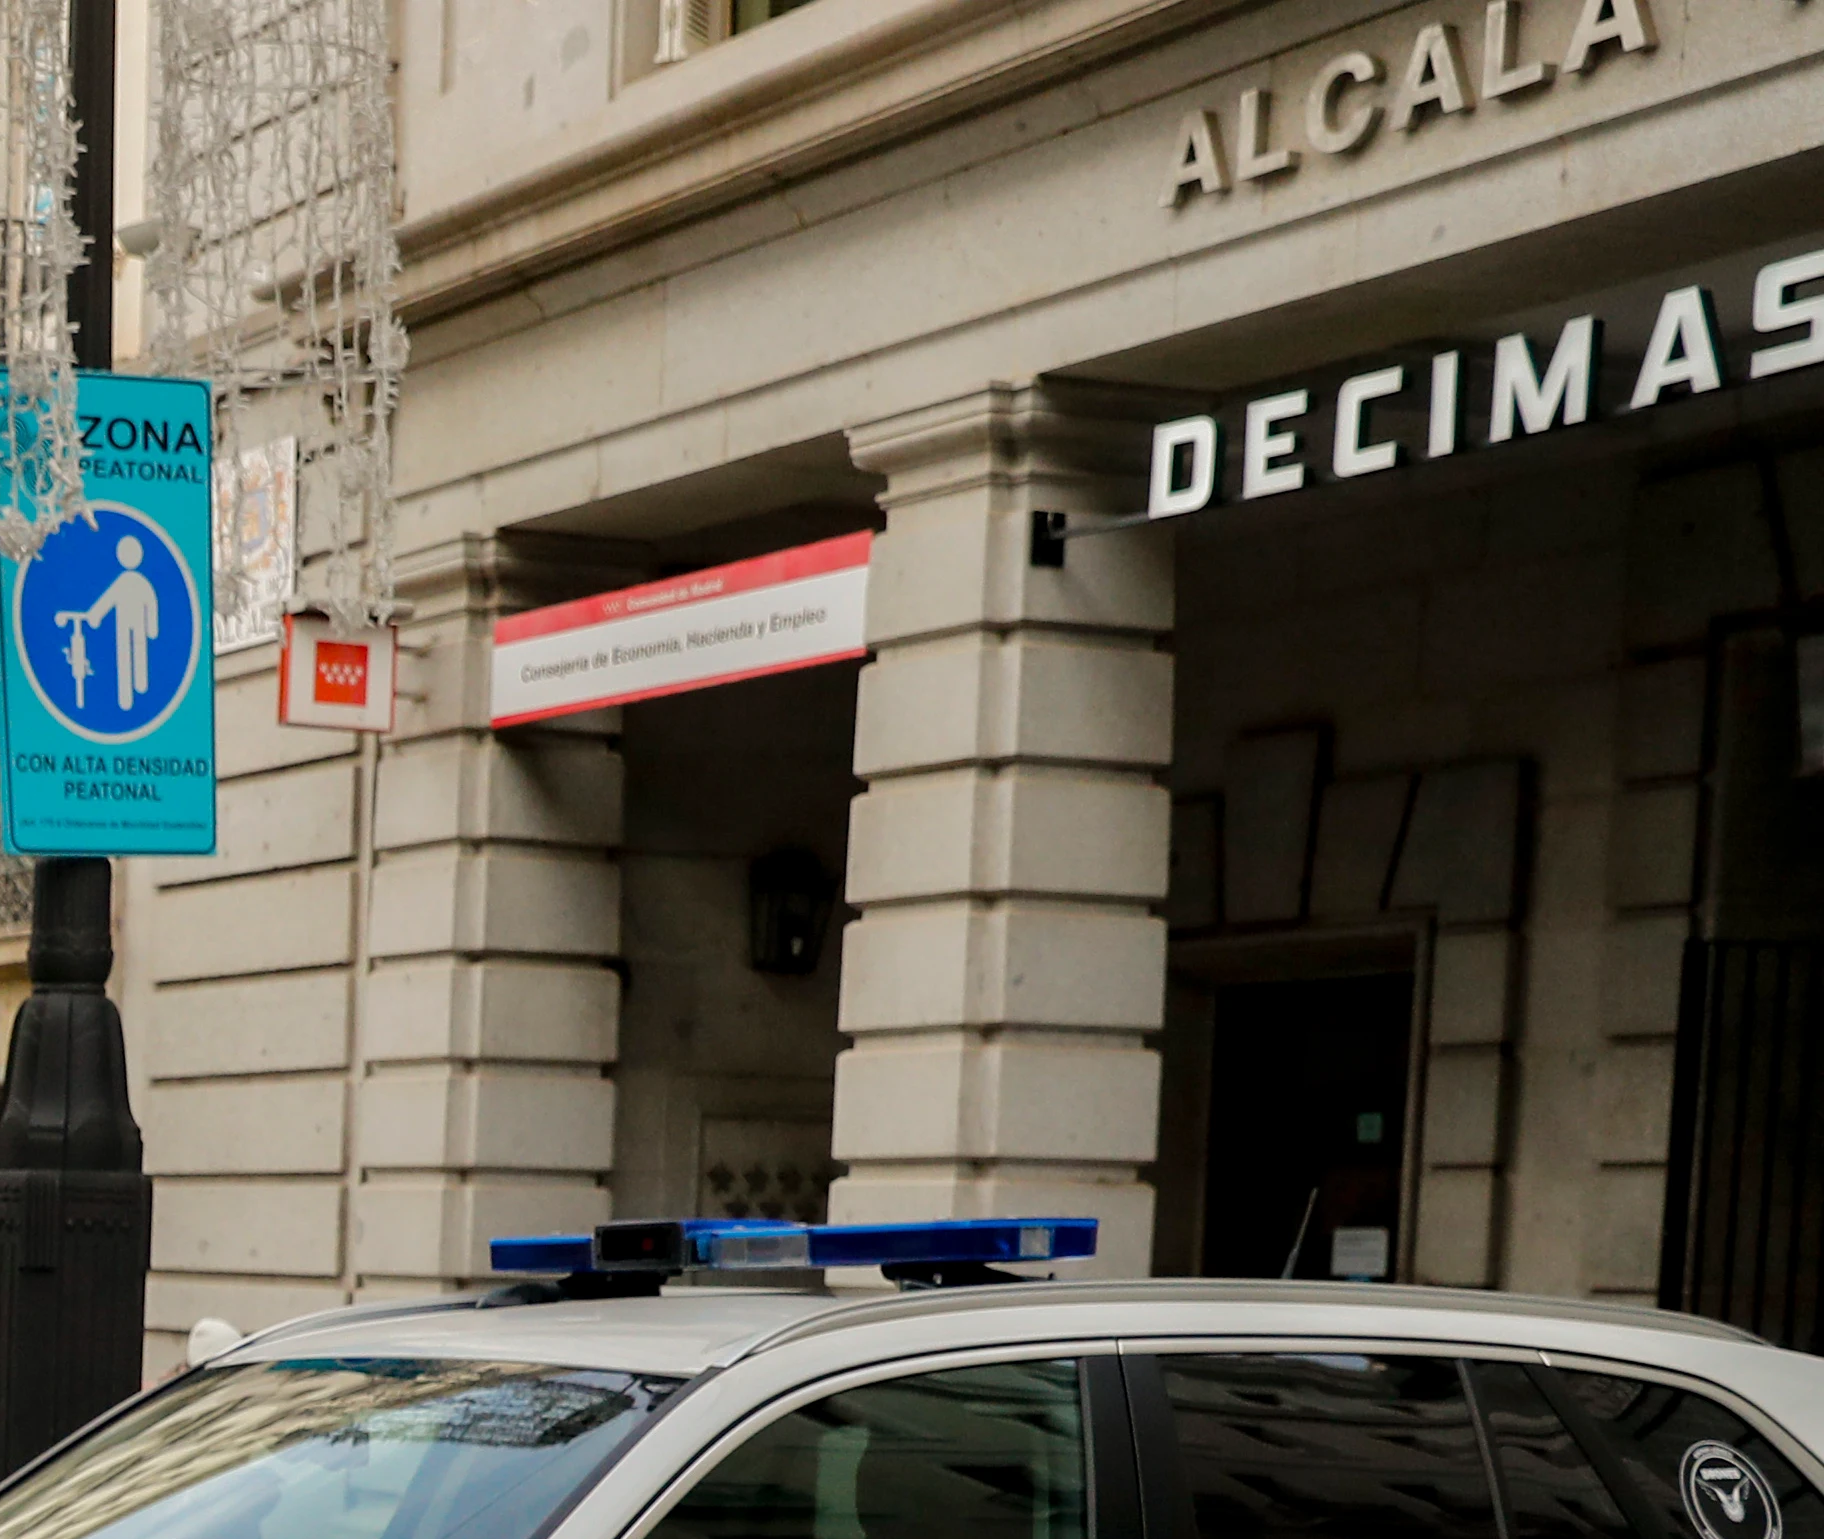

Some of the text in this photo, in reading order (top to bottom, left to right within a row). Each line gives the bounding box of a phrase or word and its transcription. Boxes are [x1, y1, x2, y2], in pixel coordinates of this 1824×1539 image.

[1159, 0, 1655, 208] ALCALA
[1148, 250, 1824, 519] DECIMAS
[79, 415, 203, 453] ZONA
[78, 458, 203, 483] PEATONAL
[520, 651, 589, 684] Consejería
[591, 651, 608, 670] de
[610, 635, 682, 666] Economía,
[685, 623, 754, 650] Hacienda
[768, 605, 827, 636] Empleo
[15, 754, 208, 777] CON ALTA DENSIDAD
[63, 782, 161, 801] PEATONAL
